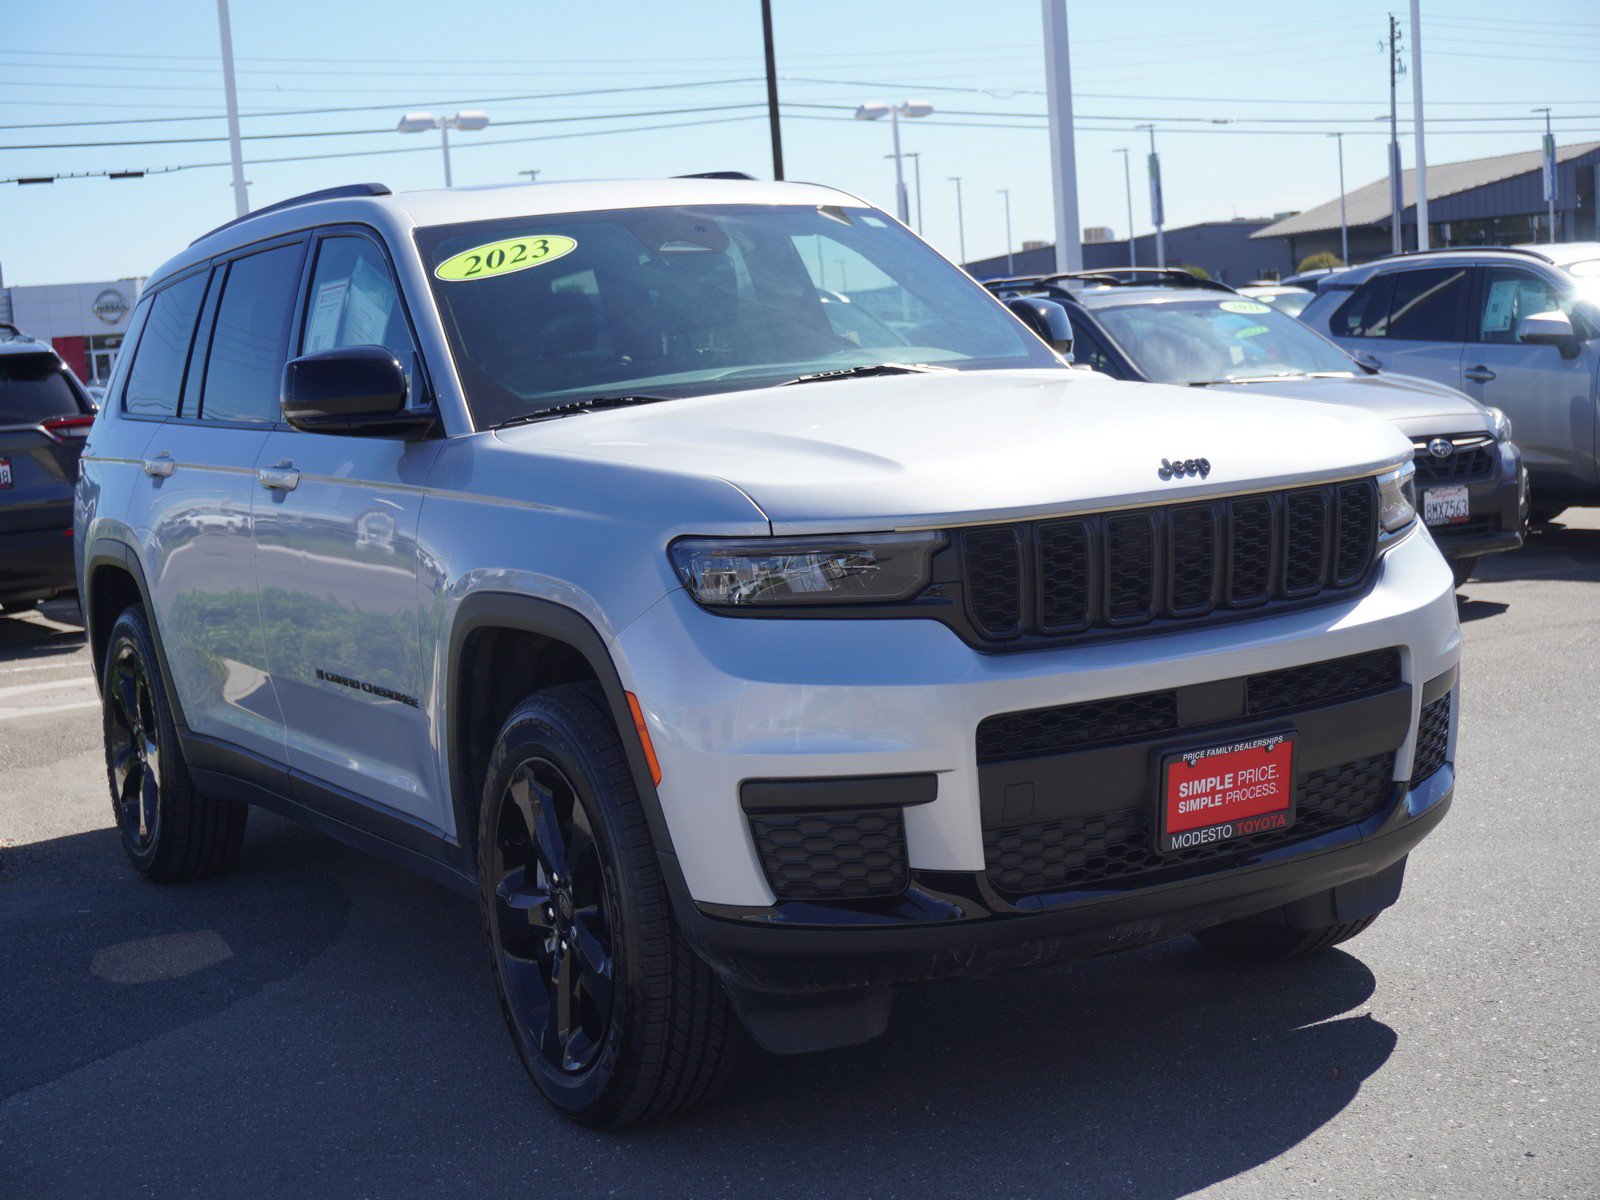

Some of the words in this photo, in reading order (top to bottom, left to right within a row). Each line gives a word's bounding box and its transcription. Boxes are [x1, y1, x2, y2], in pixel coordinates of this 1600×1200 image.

[464, 239, 550, 277] 2023
[1158, 457, 1211, 482] Jeep
[1426, 499, 1467, 520] 8MXZ563
[324, 671, 361, 690] GRAND
[361, 682, 419, 709] CHEROKEE
[1182, 750, 1205, 762] PRICE
[1206, 745, 1233, 758] FAMILY
[1234, 735, 1283, 752] DEALERSHIPS
[1178, 773, 1234, 798] SIMPLE
[1237, 763, 1279, 786] PRICE.
[1178, 793, 1223, 814] SIMPLE
[1225, 781, 1279, 805] PROCESS.
[1171, 824, 1233, 850] MODESTO
[1236, 814, 1286, 835] TOYOTA
